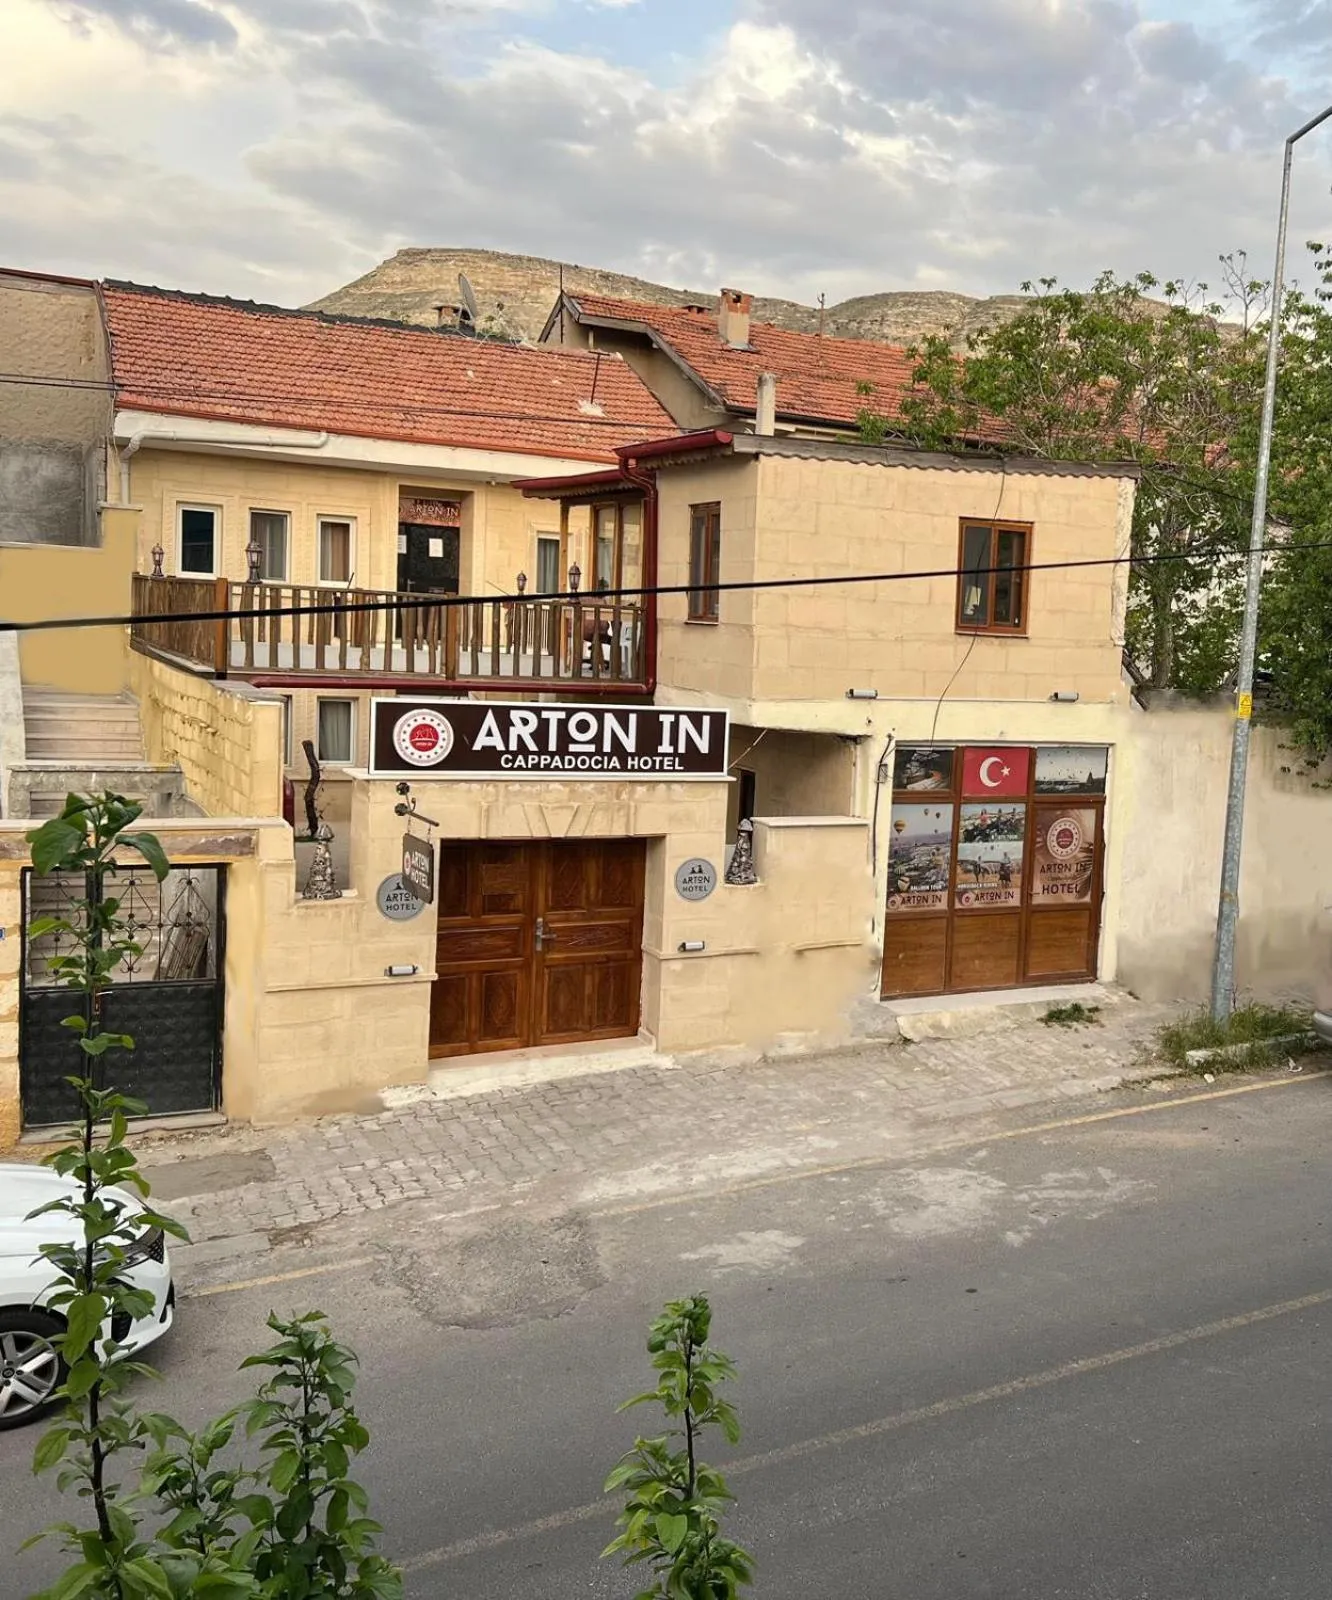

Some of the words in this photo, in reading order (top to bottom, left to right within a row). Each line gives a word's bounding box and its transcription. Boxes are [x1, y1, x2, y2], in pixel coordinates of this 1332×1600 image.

[447, 507, 459, 517] IN
[472, 708, 637, 753] ARTON
[657, 714, 711, 754] IN
[500, 754, 621, 769] CAPPADOCIA
[627, 756, 684, 770] HOTEL
[411, 850, 430, 873] ARTON
[1040, 863, 1072, 873] ARTON
[410, 869, 430, 889] HOTEL
[682, 875, 710, 884] ARTON
[901, 895, 929, 905] ARTON
[931, 894, 943, 903] IN
[975, 891, 1001, 901] ARTON
[1004, 890, 1015, 900] IN
[386, 903, 417, 911] HOTEL
